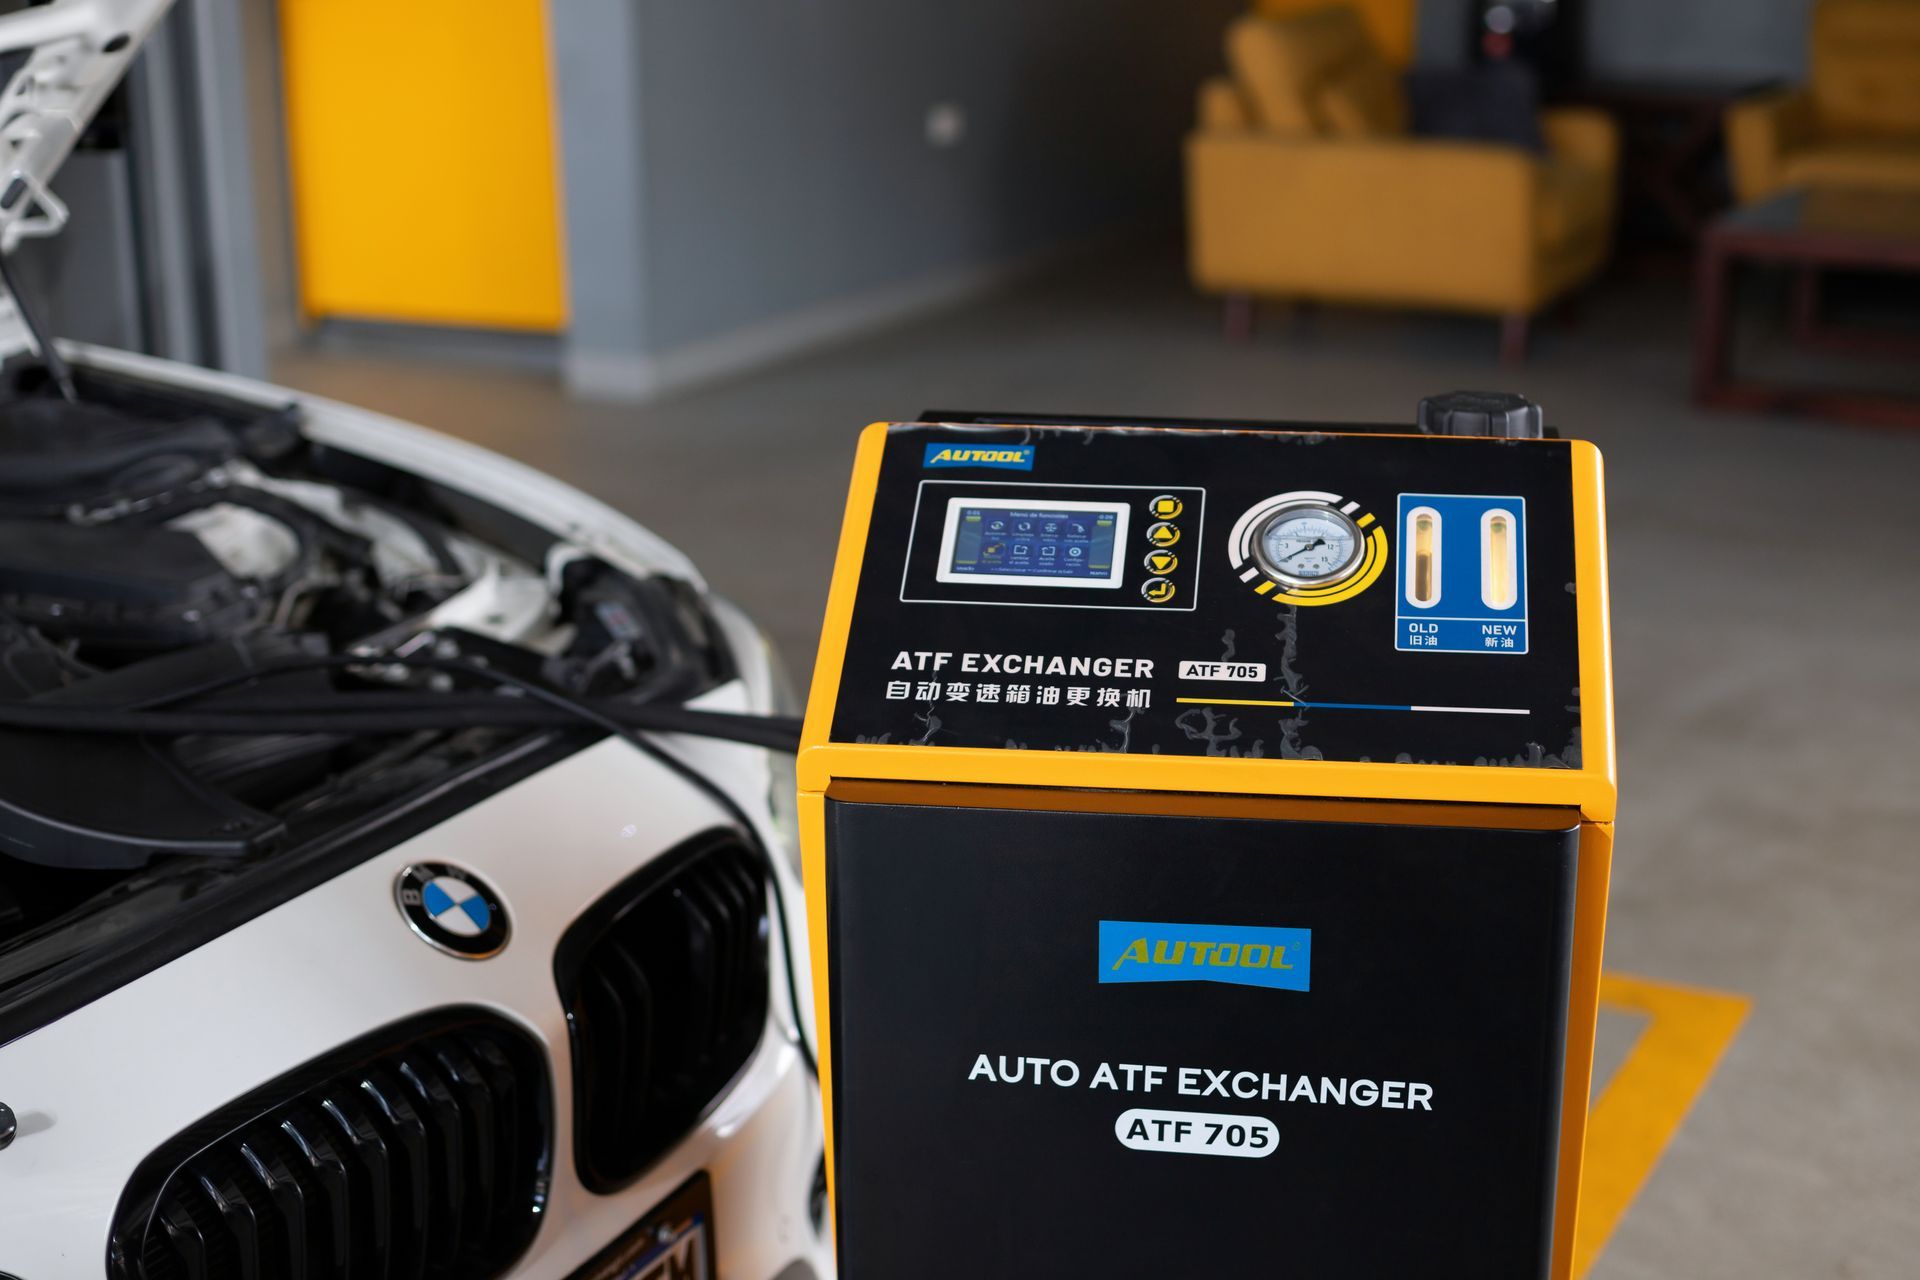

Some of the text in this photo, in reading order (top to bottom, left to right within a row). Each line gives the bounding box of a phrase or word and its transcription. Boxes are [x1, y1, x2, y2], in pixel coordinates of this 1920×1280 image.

[1408, 623, 1439, 634] OLD
[1481, 624, 1517, 635] NEW
[1409, 635, 1438, 646] 旧油
[1484, 637, 1514, 648] 新油
[891, 651, 1154, 679] ATF EXCHANGER
[1186, 664, 1259, 679] ATF 705
[886, 681, 1152, 708] 自动变速箱油更换机
[1112, 937, 1293, 970] AUTOOL
[968, 1054, 1433, 1111] AUTO ATF EXCHANGER
[1126, 1118, 1269, 1149] ATF 705
